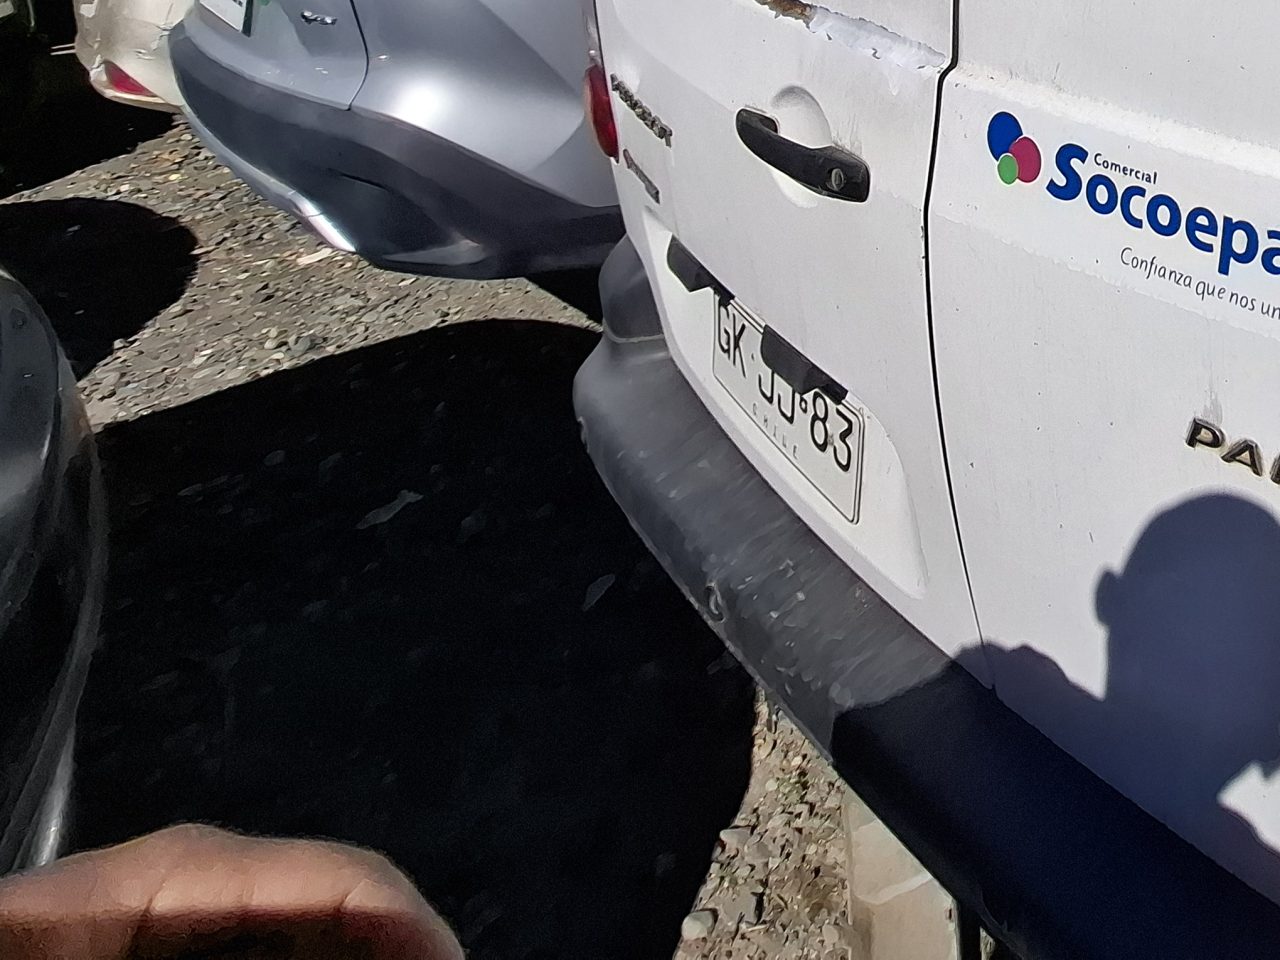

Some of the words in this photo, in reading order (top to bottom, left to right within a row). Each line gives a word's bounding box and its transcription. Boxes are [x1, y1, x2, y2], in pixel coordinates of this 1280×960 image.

[1094, 153, 1157, 184] Comercial
[1121, 247, 1192, 289] Confianza
[1195, 280, 1226, 301] que
[1229, 290, 1256, 312] nos
[752, 402, 799, 460] CHILE
